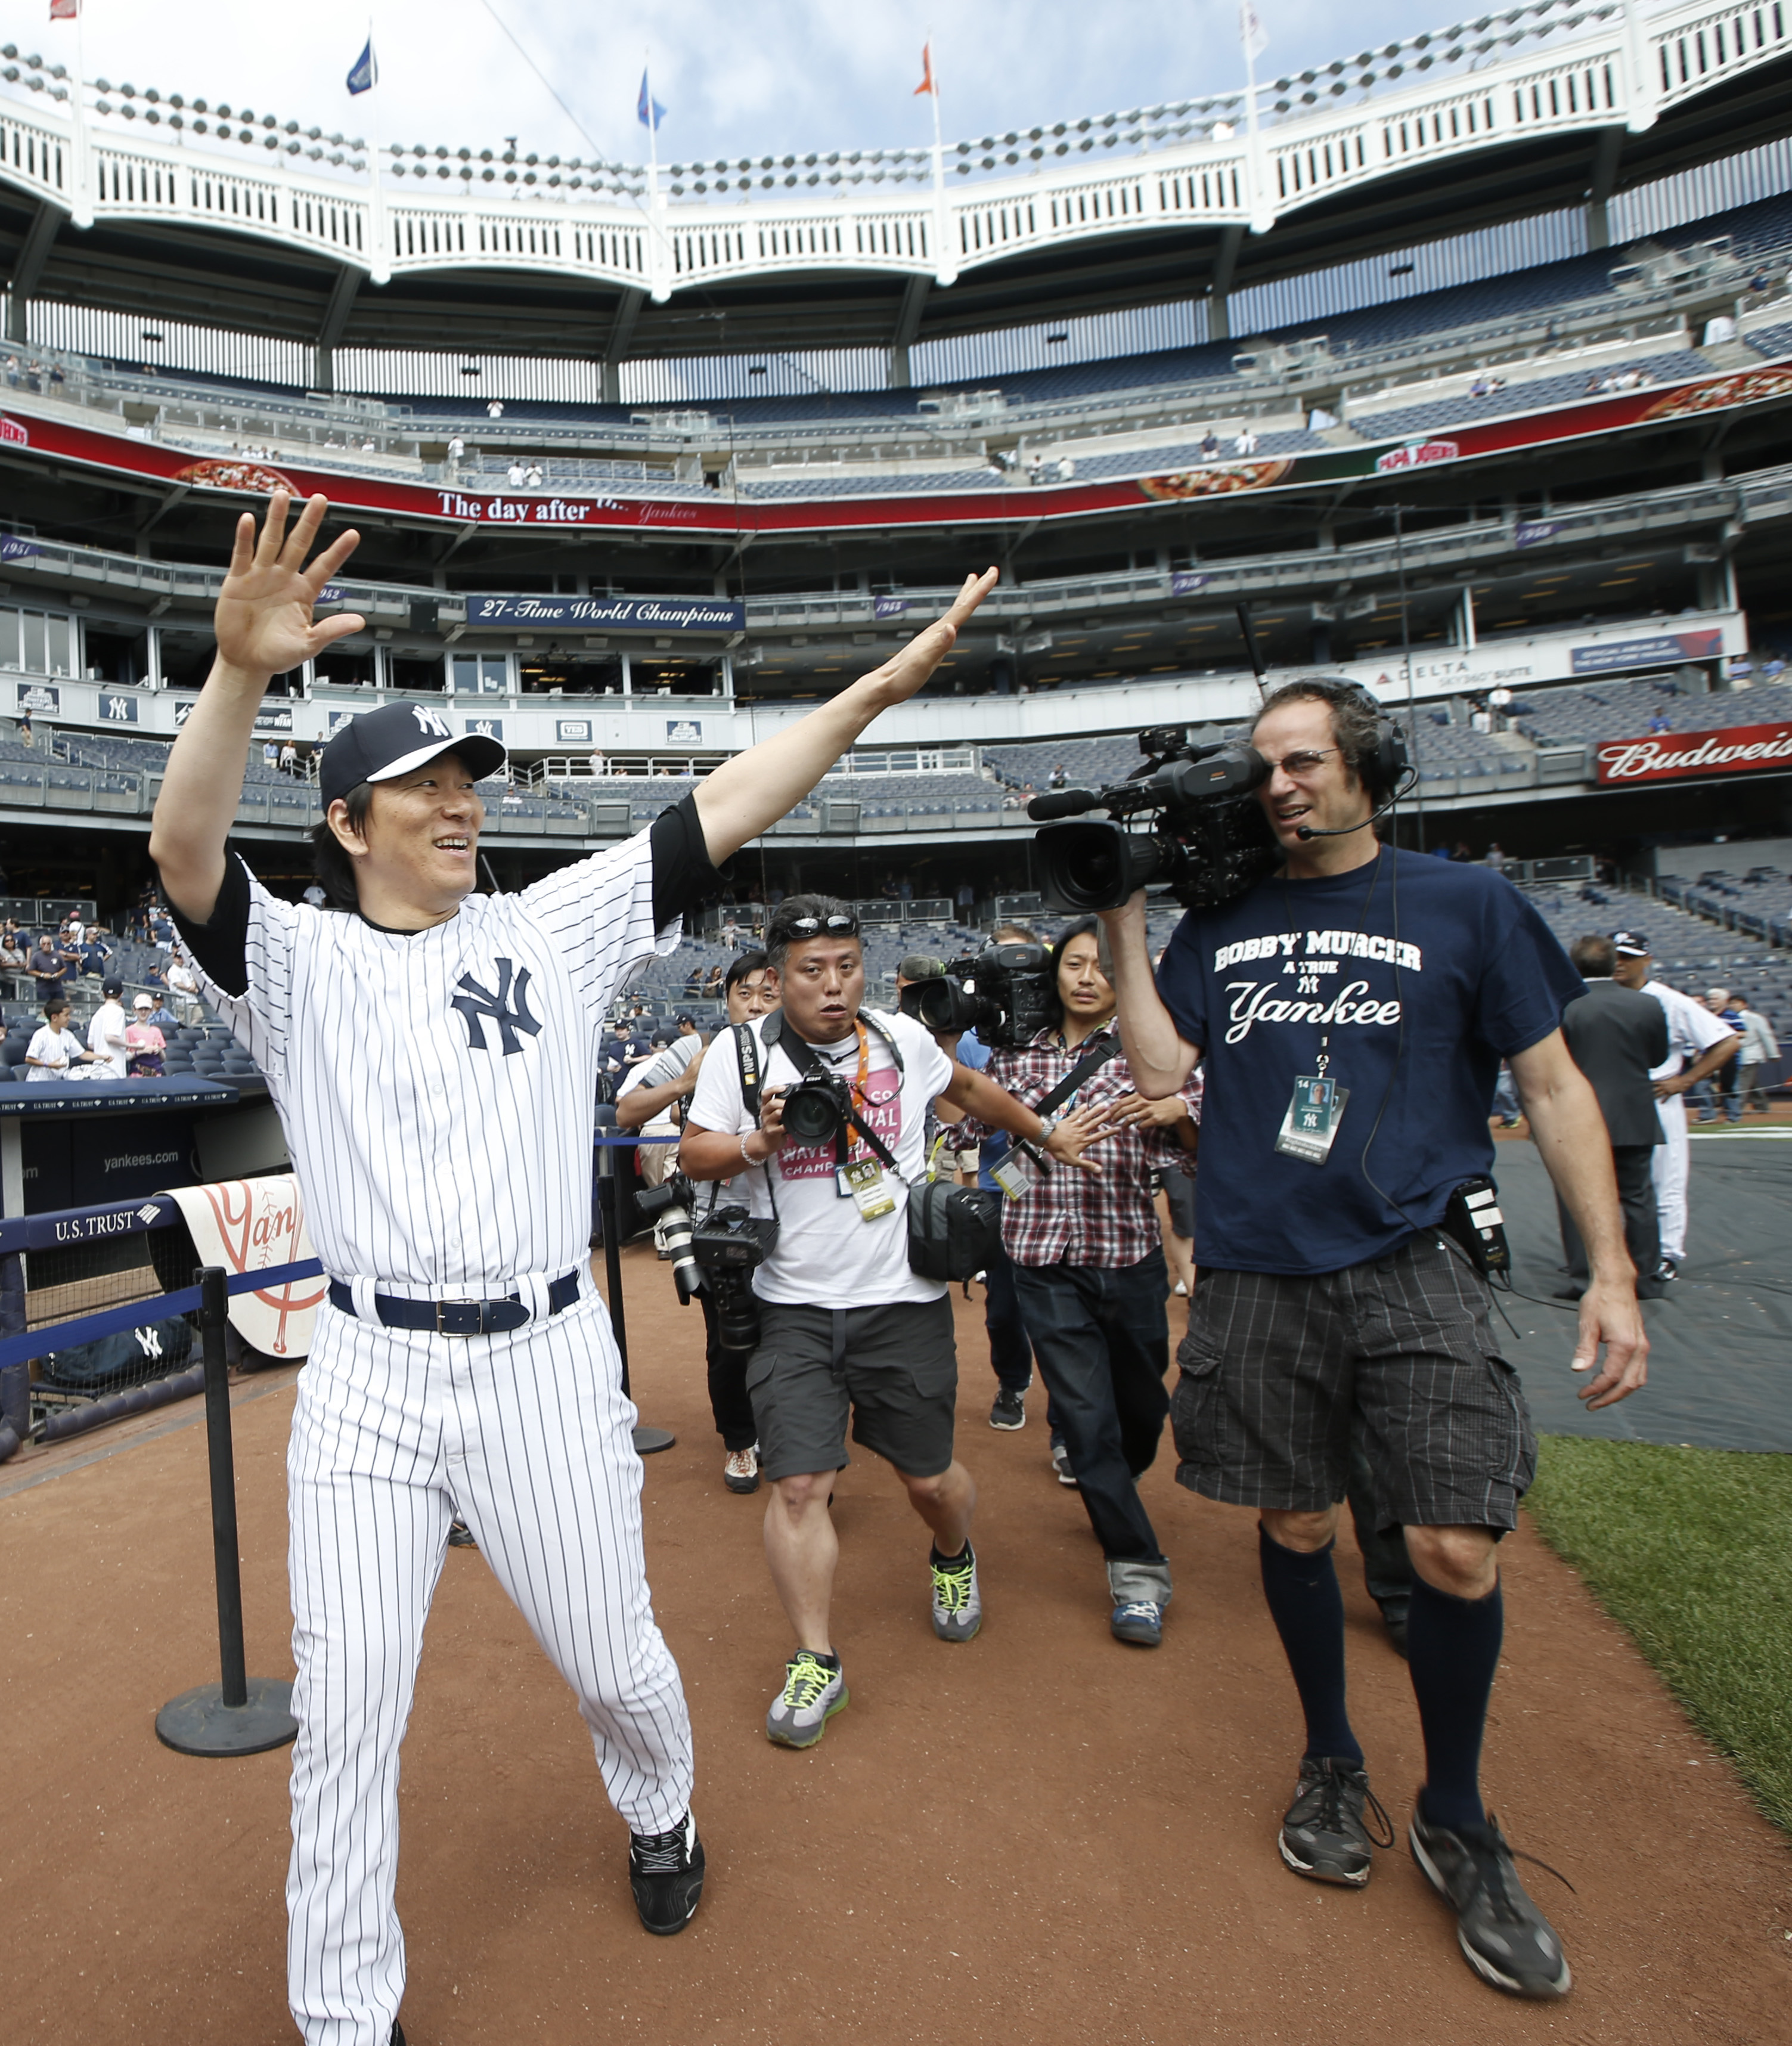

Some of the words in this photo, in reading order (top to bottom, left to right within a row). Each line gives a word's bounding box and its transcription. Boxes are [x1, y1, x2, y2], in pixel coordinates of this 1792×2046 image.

[438, 491, 481, 518] The
[487, 498, 529, 523] day
[536, 498, 590, 520] after
[637, 500, 697, 525] Yankees
[479, 599, 565, 619] 27-Time
[570, 601, 634, 621] World
[636, 603, 736, 628] Champions
[1400, 661, 1469, 681] DELTA
[1495, 665, 1533, 680] SUITE
[411, 705, 448, 736] NY
[565, 725, 584, 734] YES
[1214, 932, 1302, 972] BOBBY
[1282, 961, 1296, 974] A
[1298, 961, 1339, 974] TRUE
[450, 957, 542, 1056] NY
[1224, 980, 1401, 1044] Yankee
[741, 1046, 755, 1073] NPS
[1298, 1080, 1309, 1089] 14
[104, 1151, 178, 1173] yankees.com
[782, 1145, 829, 1162] WAVE
[55, 1220, 83, 1241] U.S.
[86, 1211, 134, 1236] TRUST
